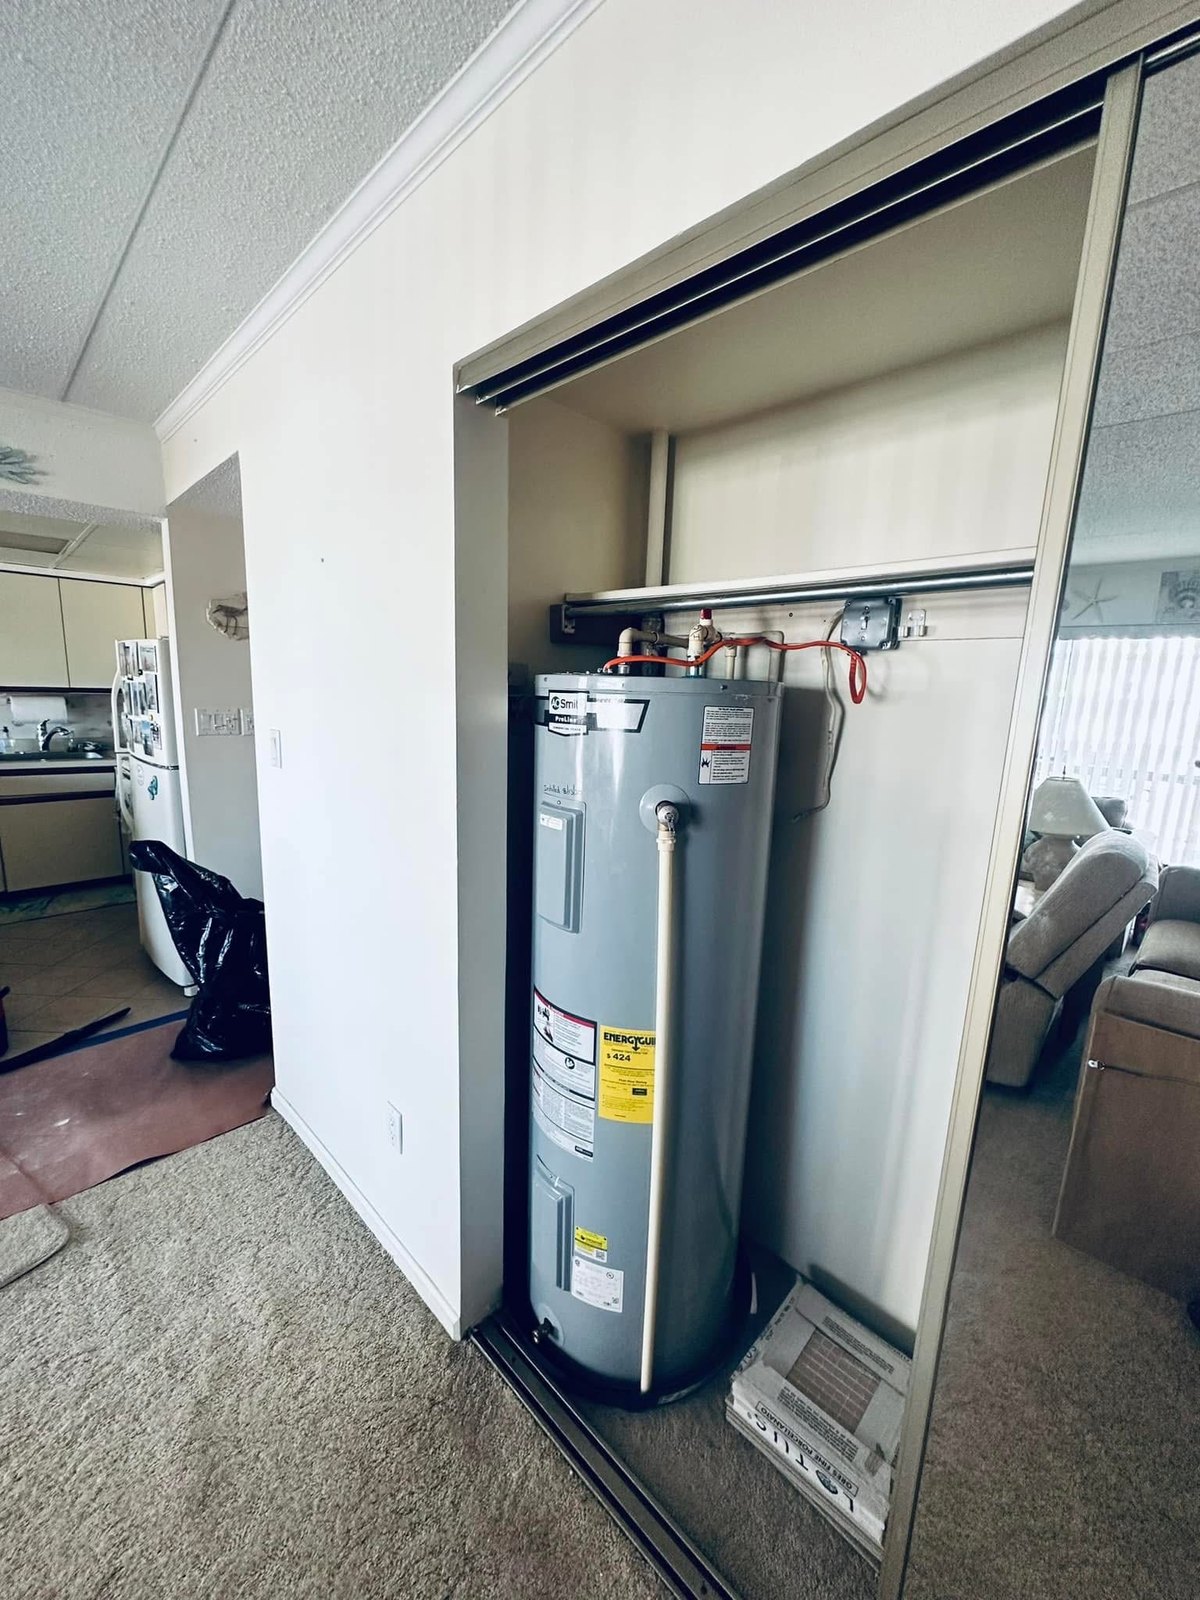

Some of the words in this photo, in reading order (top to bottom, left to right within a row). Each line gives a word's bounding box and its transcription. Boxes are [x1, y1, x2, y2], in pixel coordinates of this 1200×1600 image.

[612, 1053, 631, 1062] 424
[760, 1406, 813, 1455] PORCELLANATO
[814, 1455, 832, 1471] FINE
